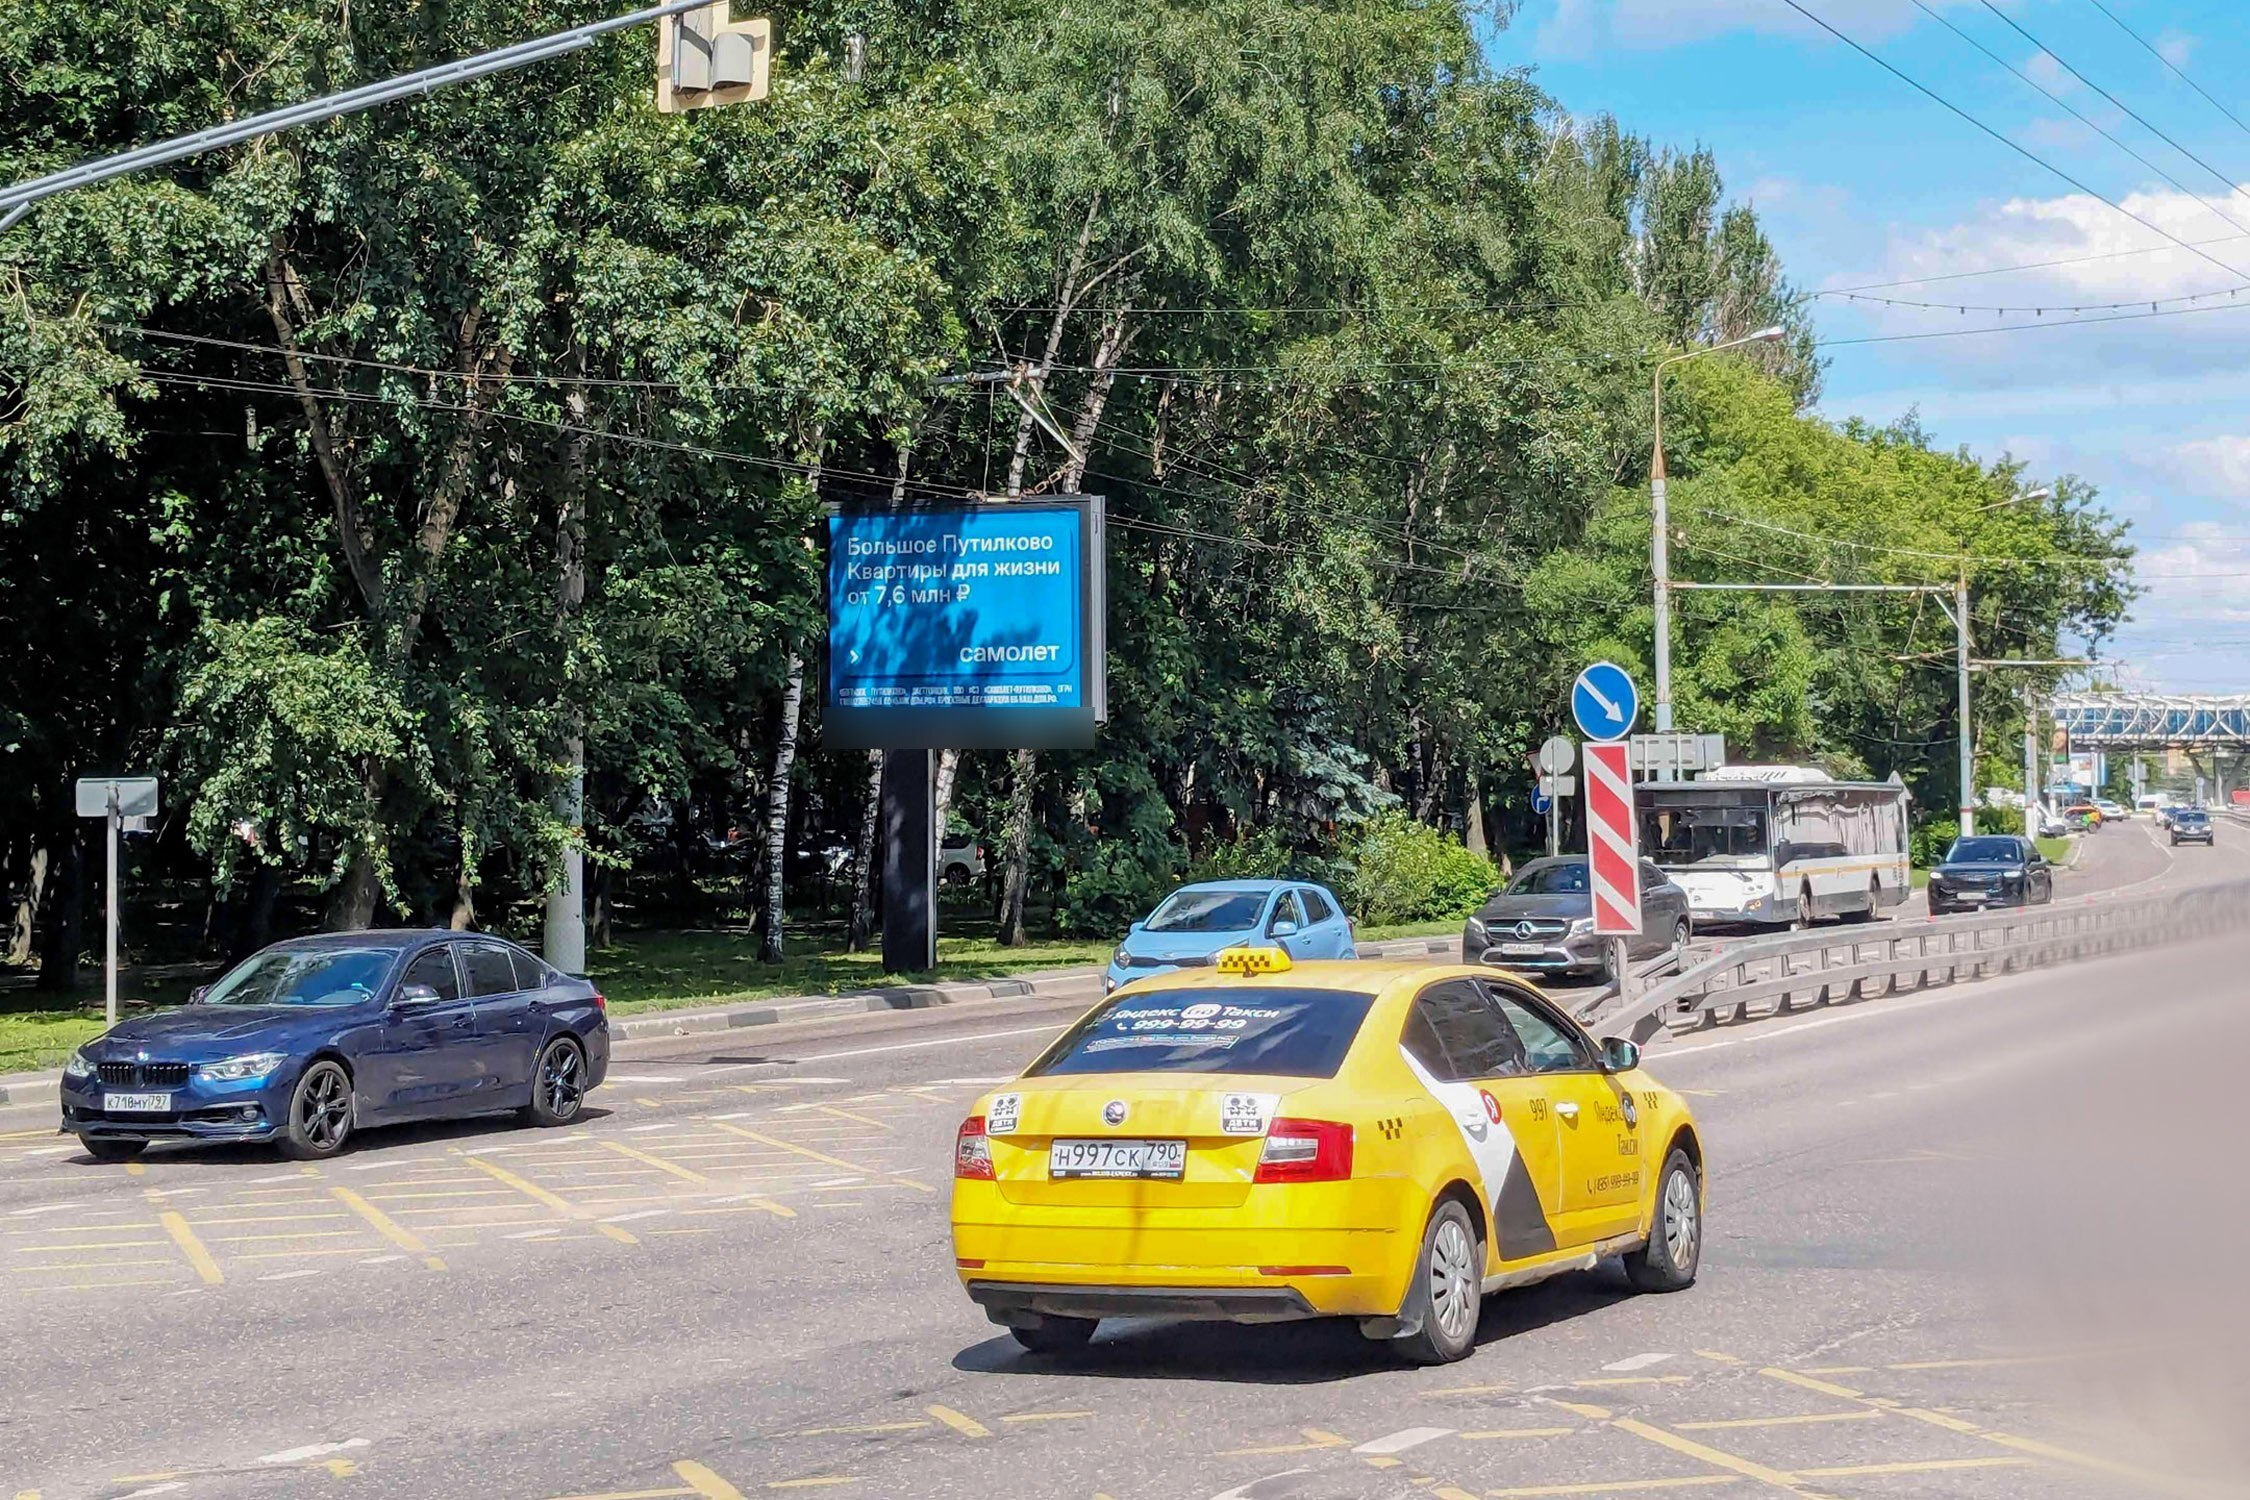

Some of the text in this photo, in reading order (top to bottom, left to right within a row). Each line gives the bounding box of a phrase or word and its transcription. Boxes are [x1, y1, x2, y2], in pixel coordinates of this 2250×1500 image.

[847, 533, 1054, 557] Большое Путилково
[847, 559, 1061, 583] Квартиры для жизни
[847, 590, 869, 605] от
[874, 585, 906, 608] 7,6
[911, 589, 951, 604] млн
[959, 642, 1061, 664] самолет
[1111, 1006, 1281, 1020] Яндекс Такси
[1131, 1018, 1248, 1031] 999-99-99
[1529, 1097, 1548, 1122] 997
[1146, 1142, 1179, 1161] 790
